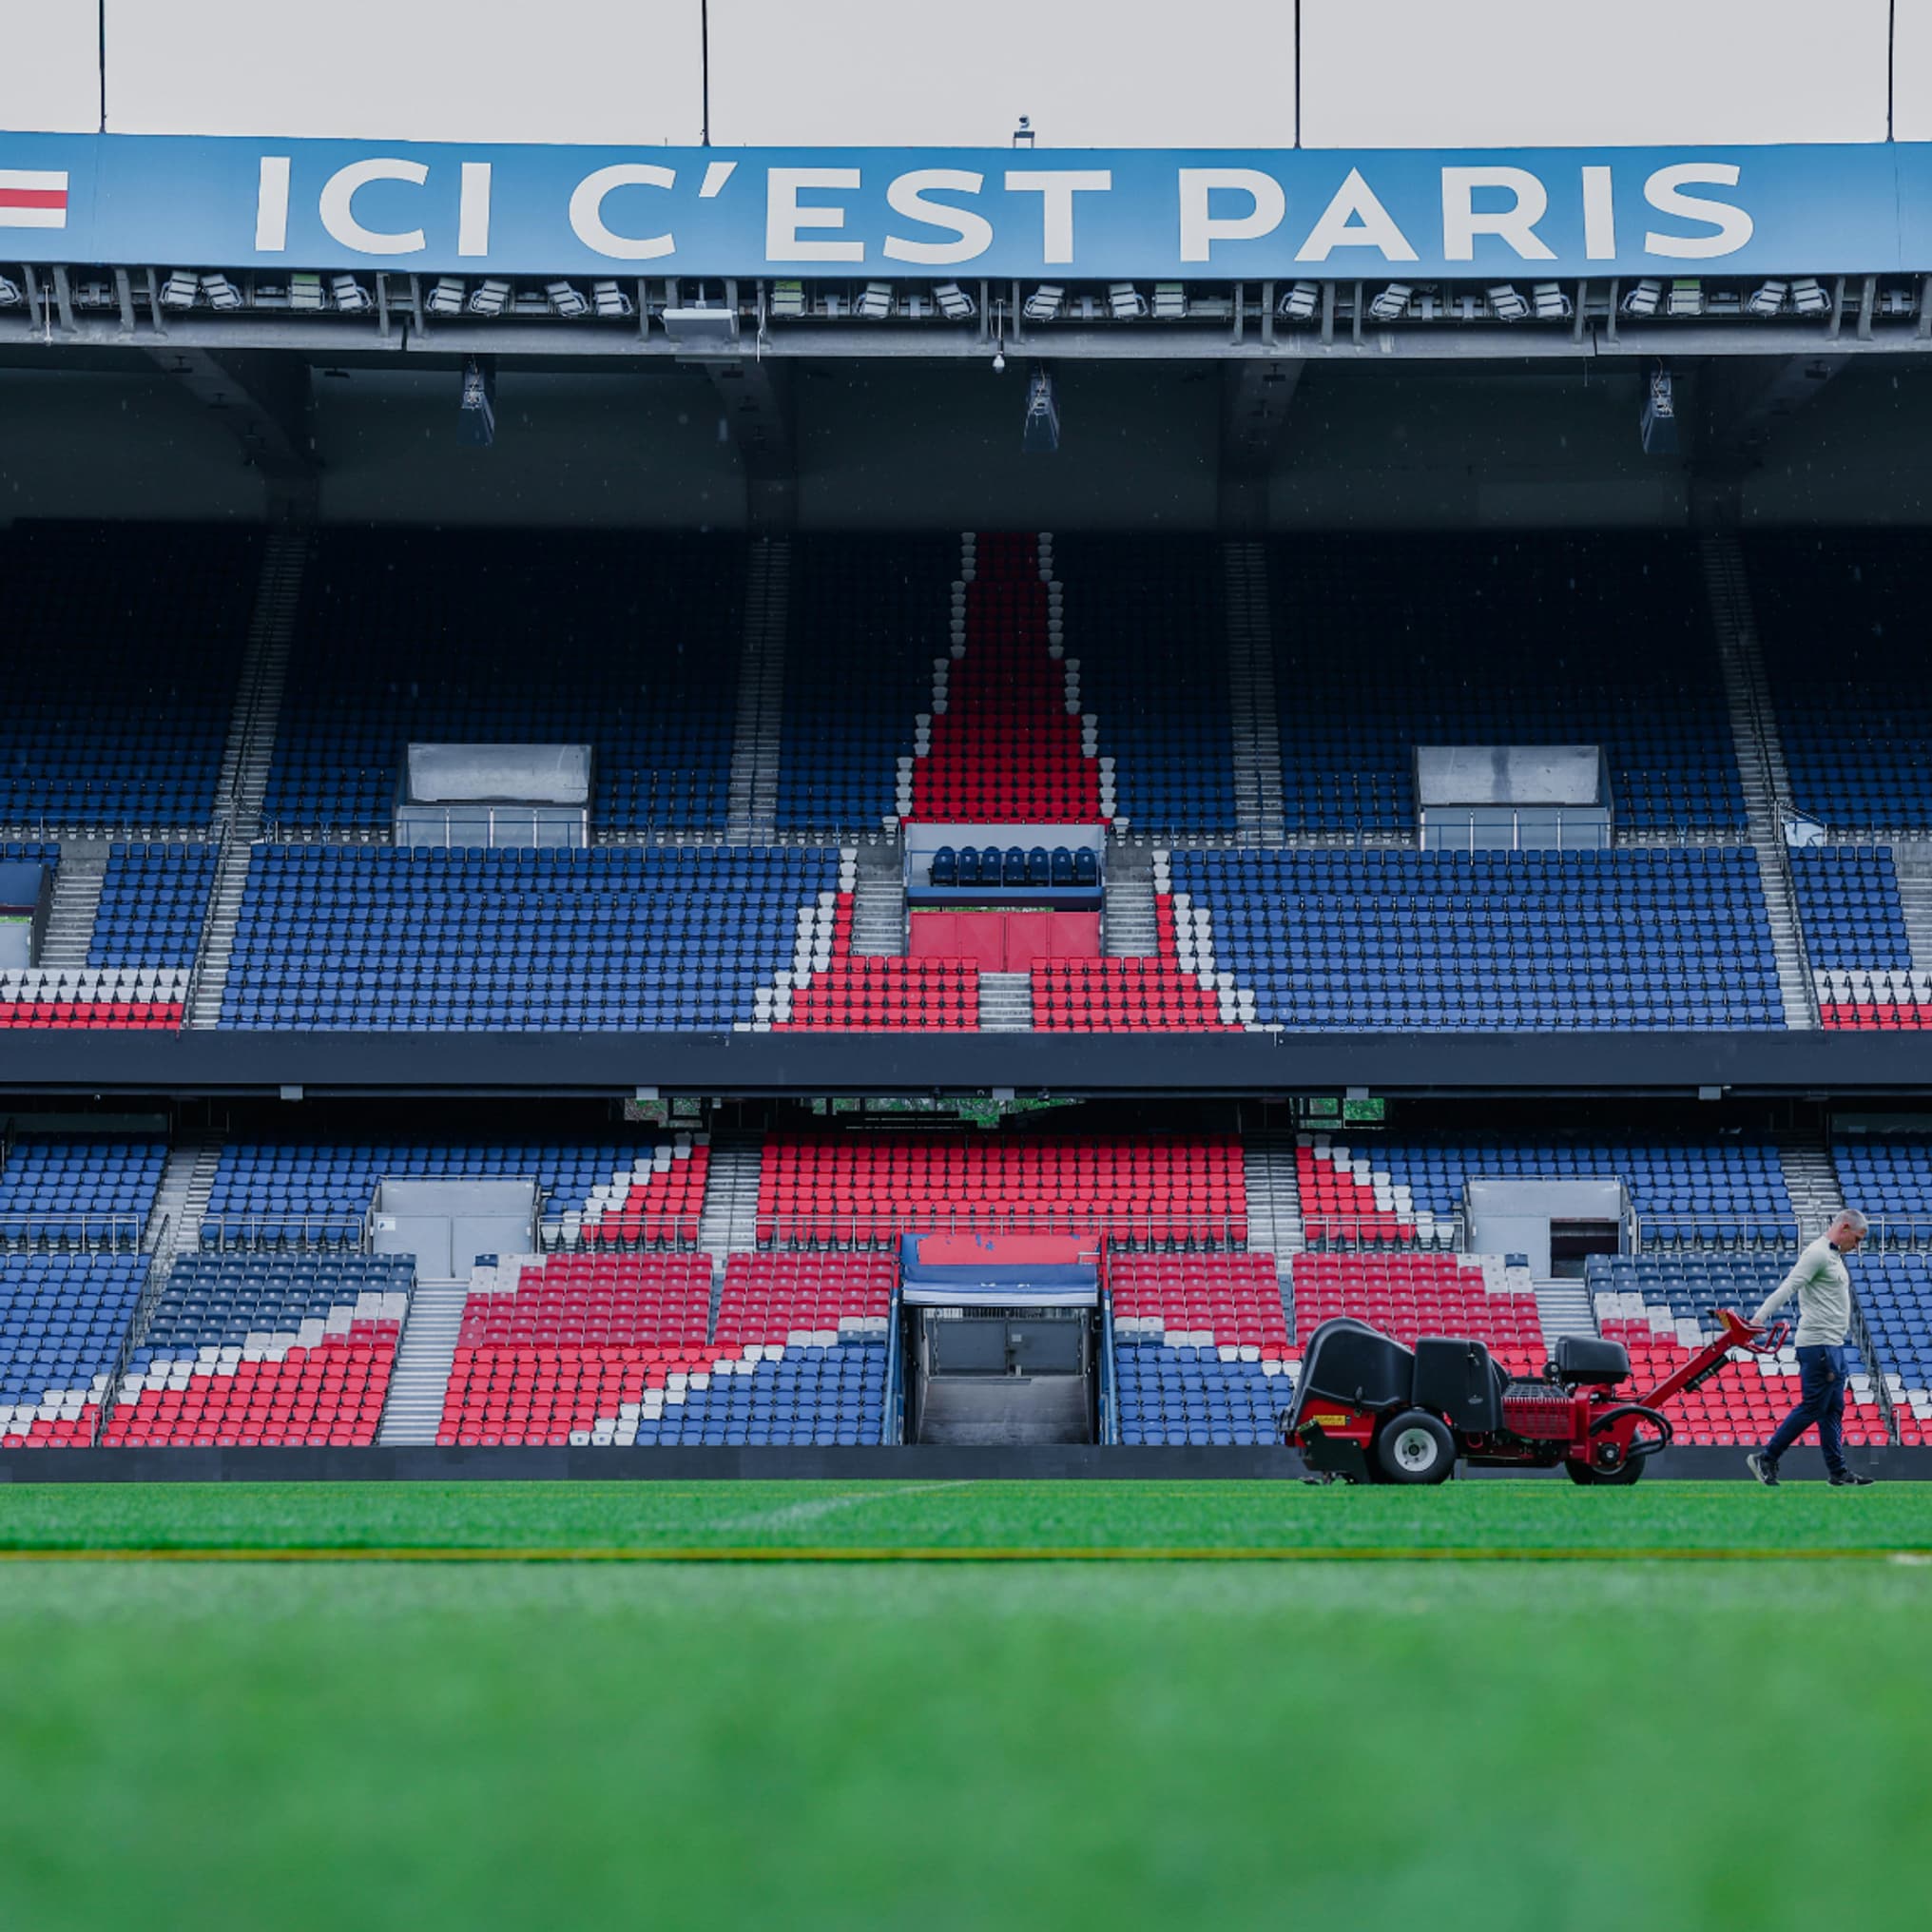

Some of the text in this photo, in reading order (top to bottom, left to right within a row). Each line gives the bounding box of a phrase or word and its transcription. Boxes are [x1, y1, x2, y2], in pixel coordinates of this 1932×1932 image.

[255, 156, 1755, 265] ICI C'EST PARIS
